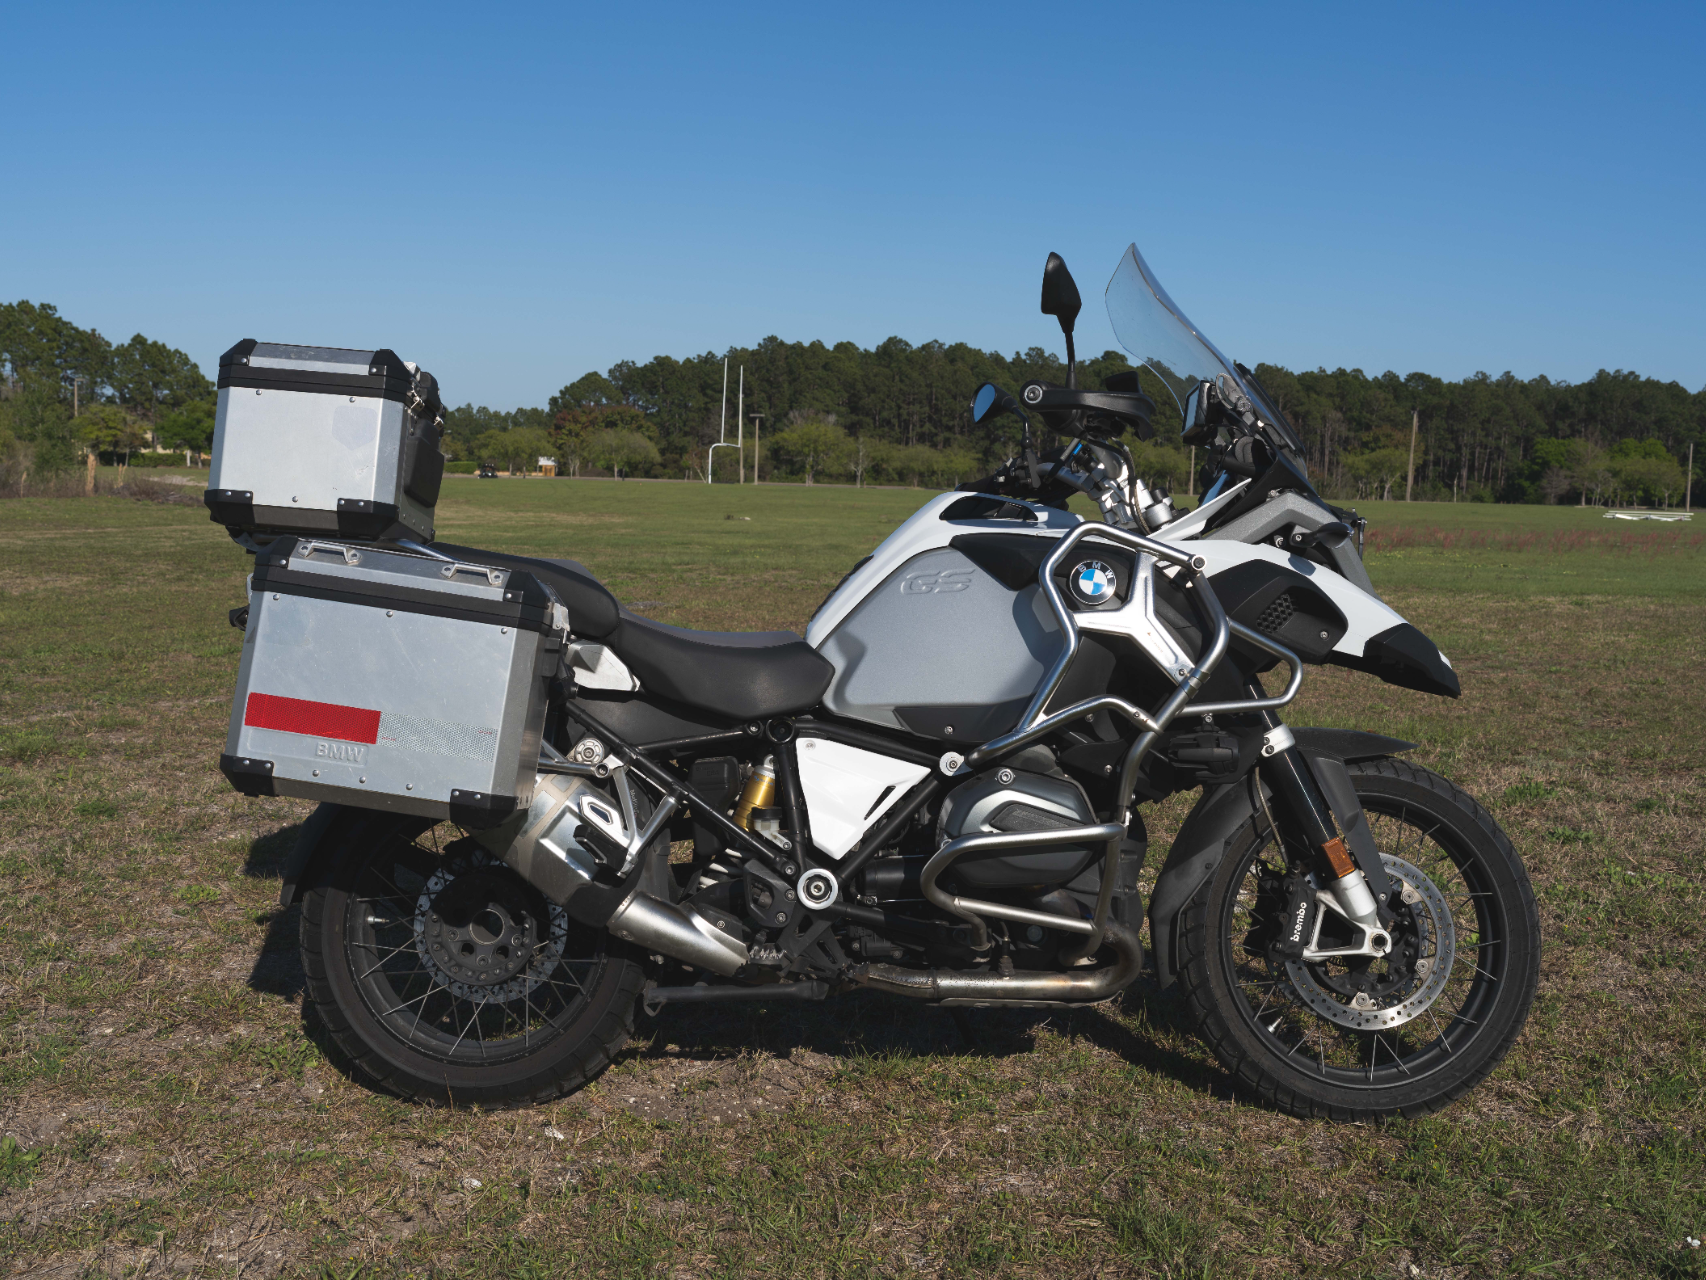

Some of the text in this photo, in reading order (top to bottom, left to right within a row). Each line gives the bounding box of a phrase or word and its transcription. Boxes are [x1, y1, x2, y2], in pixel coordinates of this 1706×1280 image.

[900, 568, 976, 595] GS
[1077, 561, 1114, 579] BMW
[315, 741, 364, 762] BMW
[1289, 901, 1308, 942] brembo
